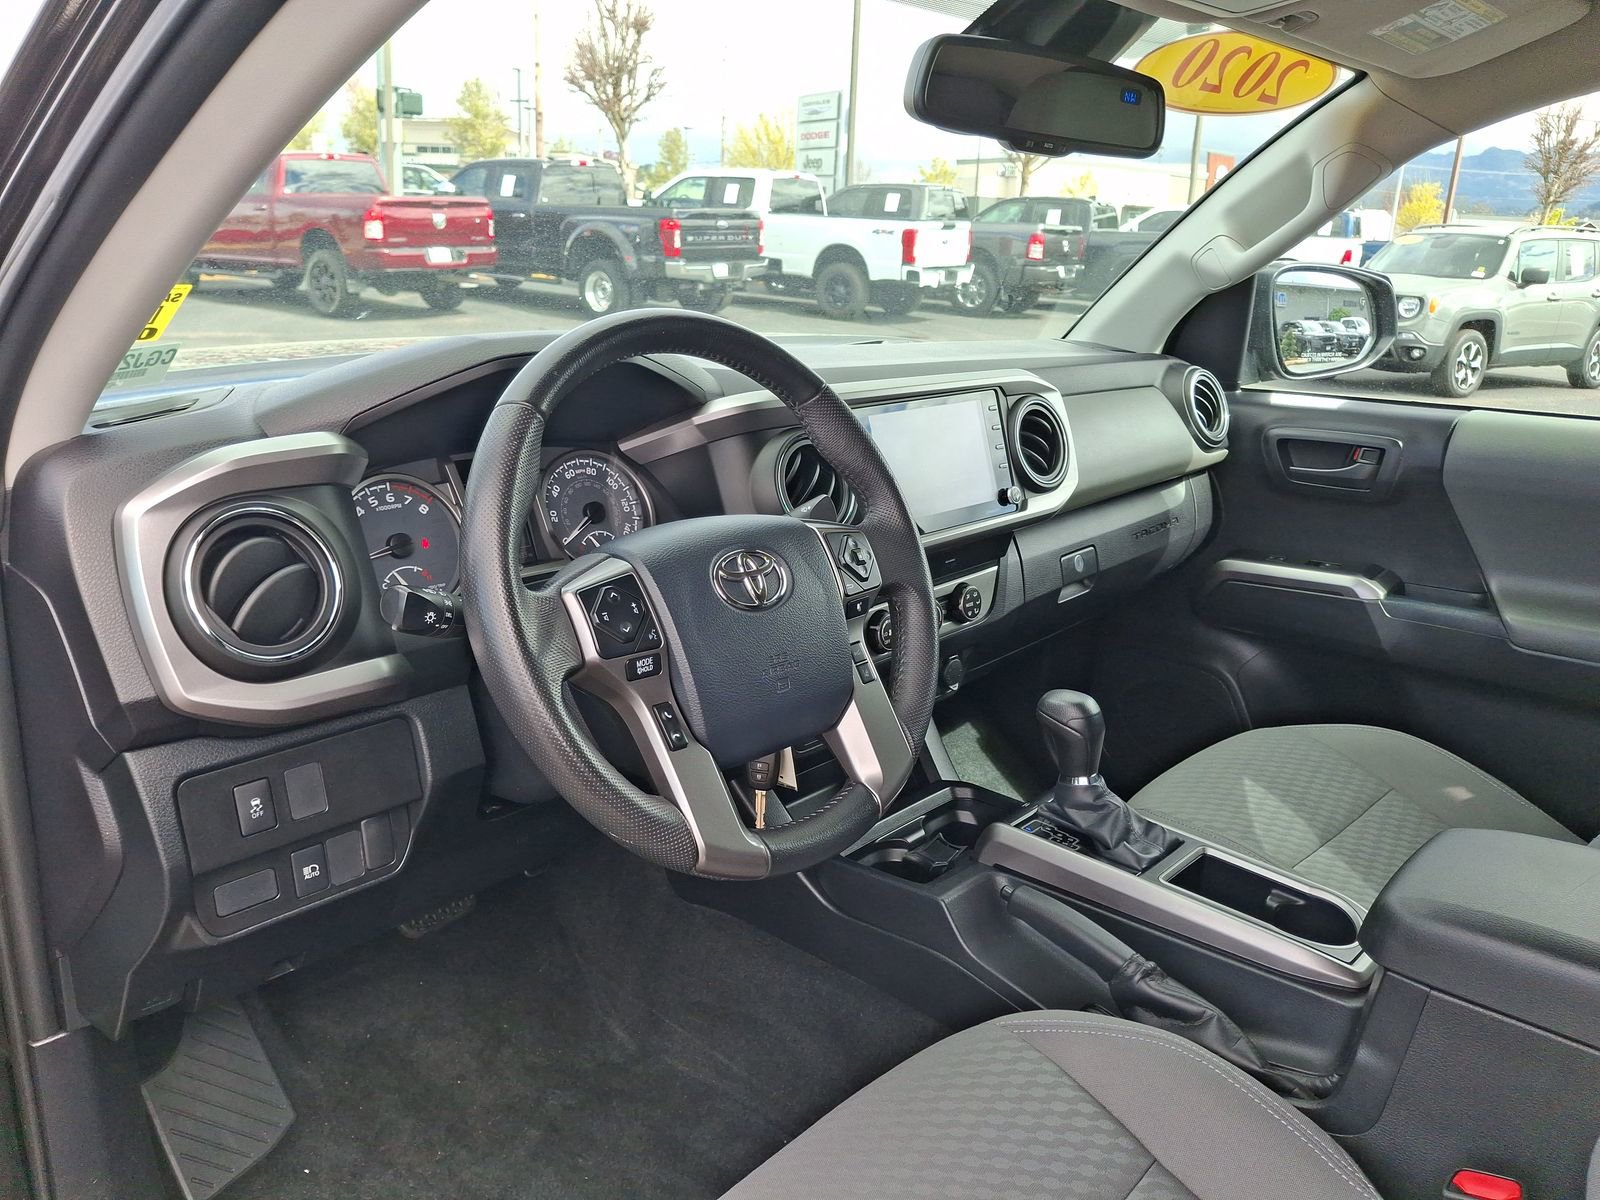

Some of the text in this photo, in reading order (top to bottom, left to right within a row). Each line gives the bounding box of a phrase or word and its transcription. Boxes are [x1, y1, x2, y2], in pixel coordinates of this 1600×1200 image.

[800, 131, 830, 141] DODGE
[803, 154, 823, 171] Jeep
[565, 469, 576, 479] 60
[586, 467, 597, 476] 80
[606, 477, 619, 490] 100
[552, 485, 560, 498] 40
[368, 496, 379, 507] 5
[386, 493, 395, 502] 6
[404, 495, 412, 504] 7
[418, 504, 429, 514] 8
[620, 498, 631, 512] 120
[356, 506, 365, 517] 4
[549, 510, 559, 523] 20
[637, 657, 653, 667] MODE
[251, 811, 263, 819] OFF
[304, 870, 320, 880] AUTO
